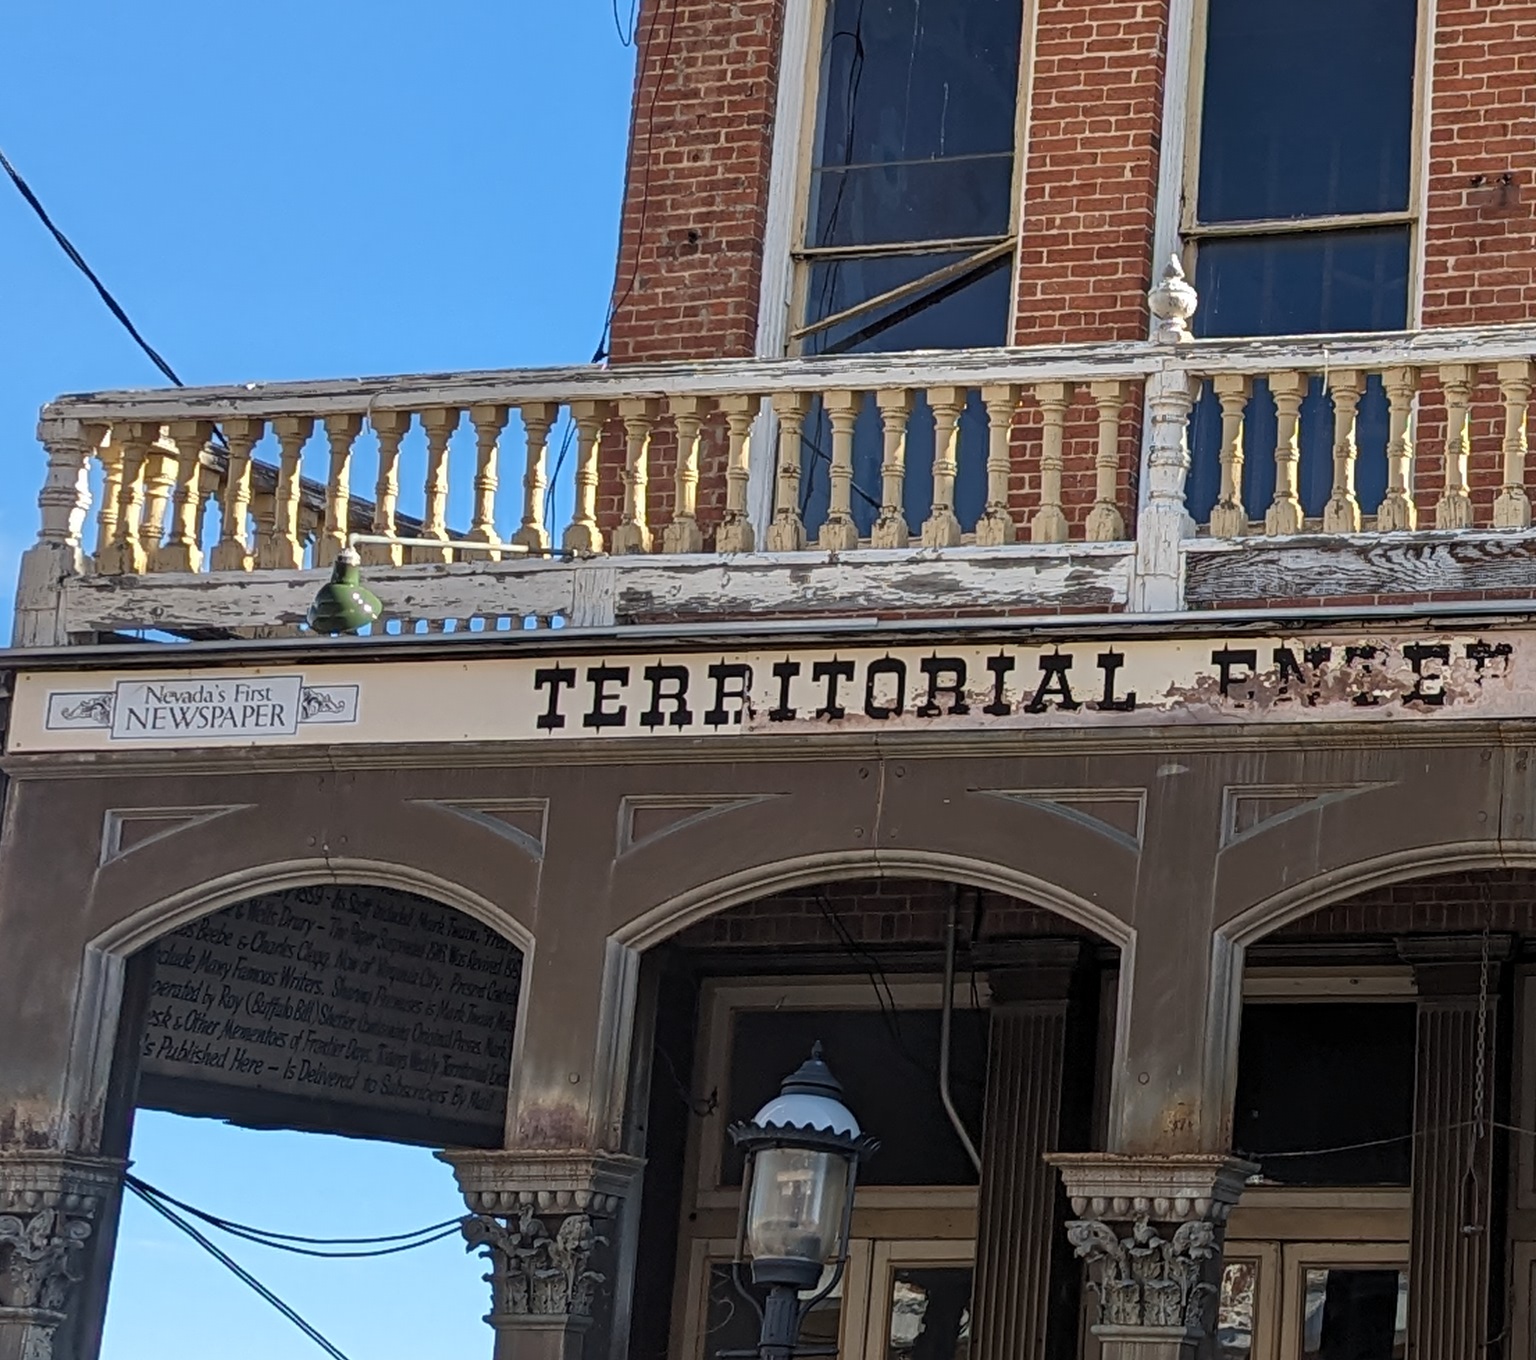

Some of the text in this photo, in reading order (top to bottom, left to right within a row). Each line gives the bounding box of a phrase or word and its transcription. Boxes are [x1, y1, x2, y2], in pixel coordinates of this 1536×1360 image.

[145, 683, 274, 705] Nevada's First
[533, 645, 1137, 733] TERRITORIAL
[125, 703, 287, 731] NEWSPAPER
[217, 984, 245, 1015] Roy
[184, 1009, 221, 1036] Other
[156, 1036, 231, 1068] Published
[228, 1047, 265, 1075] Here
[283, 1056, 297, 1080] Is
[297, 1058, 360, 1090] Delivered
